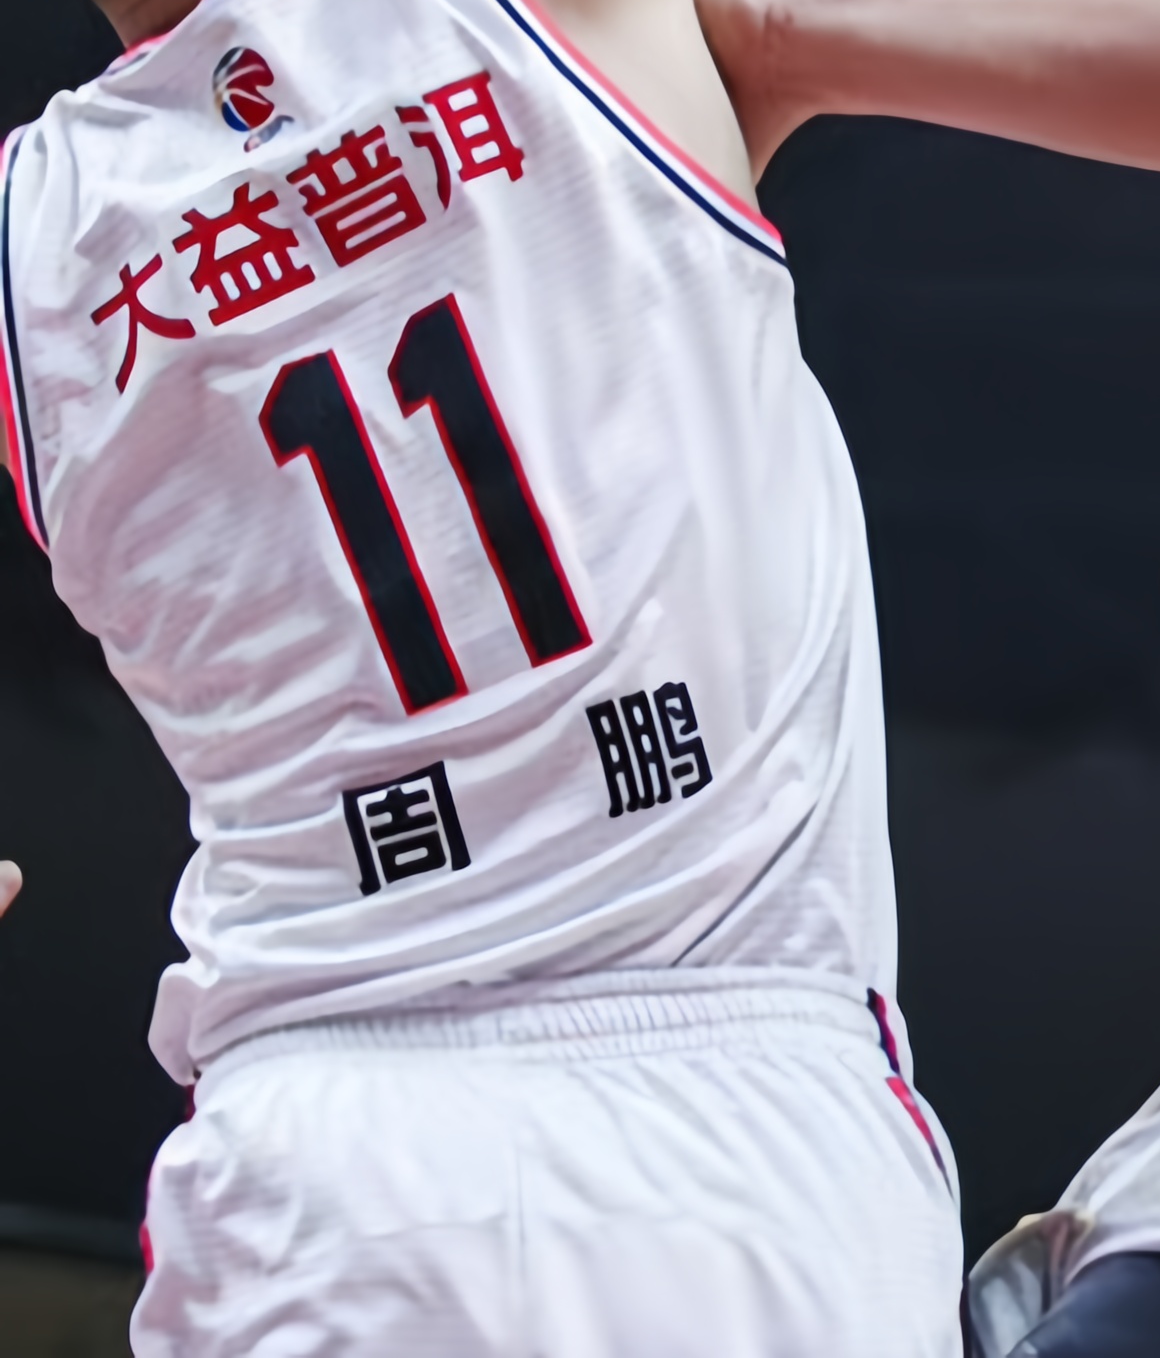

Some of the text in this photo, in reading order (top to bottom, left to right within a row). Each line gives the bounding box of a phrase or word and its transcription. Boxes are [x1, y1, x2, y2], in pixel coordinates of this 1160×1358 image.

[90, 69, 525, 395] 大益普洱
[258, 292, 594, 717] 11
